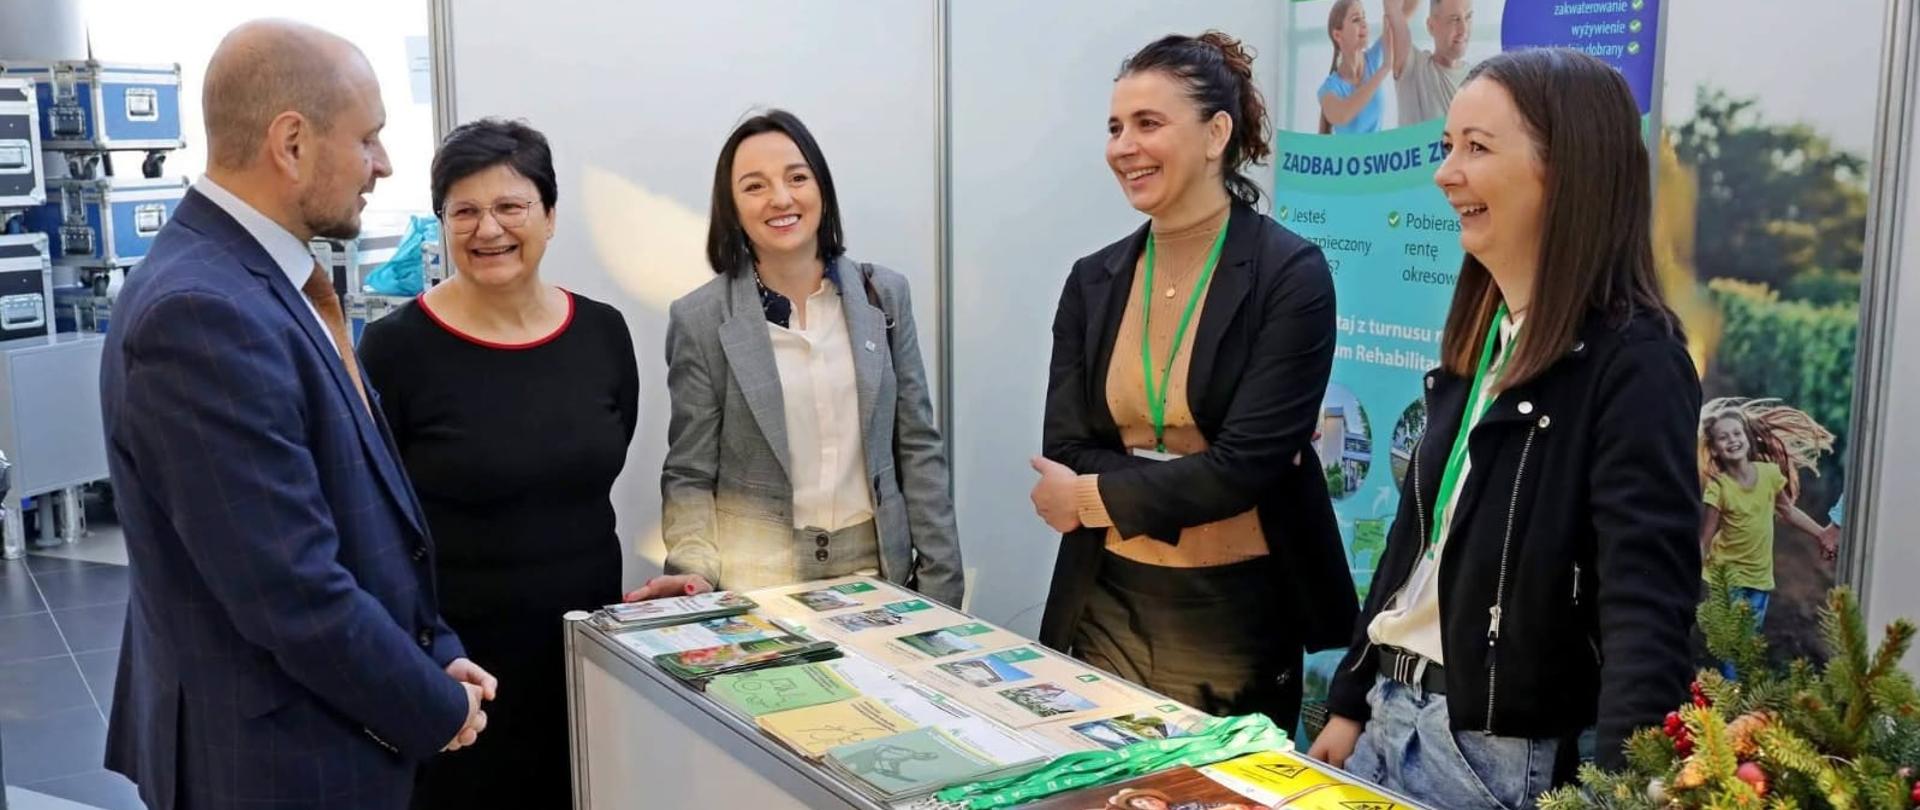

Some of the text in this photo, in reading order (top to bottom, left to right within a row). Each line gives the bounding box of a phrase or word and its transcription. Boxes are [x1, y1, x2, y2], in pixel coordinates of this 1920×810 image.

[1554, 1, 1628, 15] zakwaterowanie
[1571, 20, 1625, 38] wyżywienie
[1585, 42, 1624, 58] dobrany
[1283, 140, 1446, 176] ZADBAJ O SWOJE Z
[1292, 207, 1326, 224] Jesteś
[1406, 212, 1462, 232] Pobieras
[1404, 243, 1439, 261] rentę
[1402, 266, 1457, 285] okresow
[1357, 320, 1366, 333] z
[1369, 319, 1431, 342] turnusu
